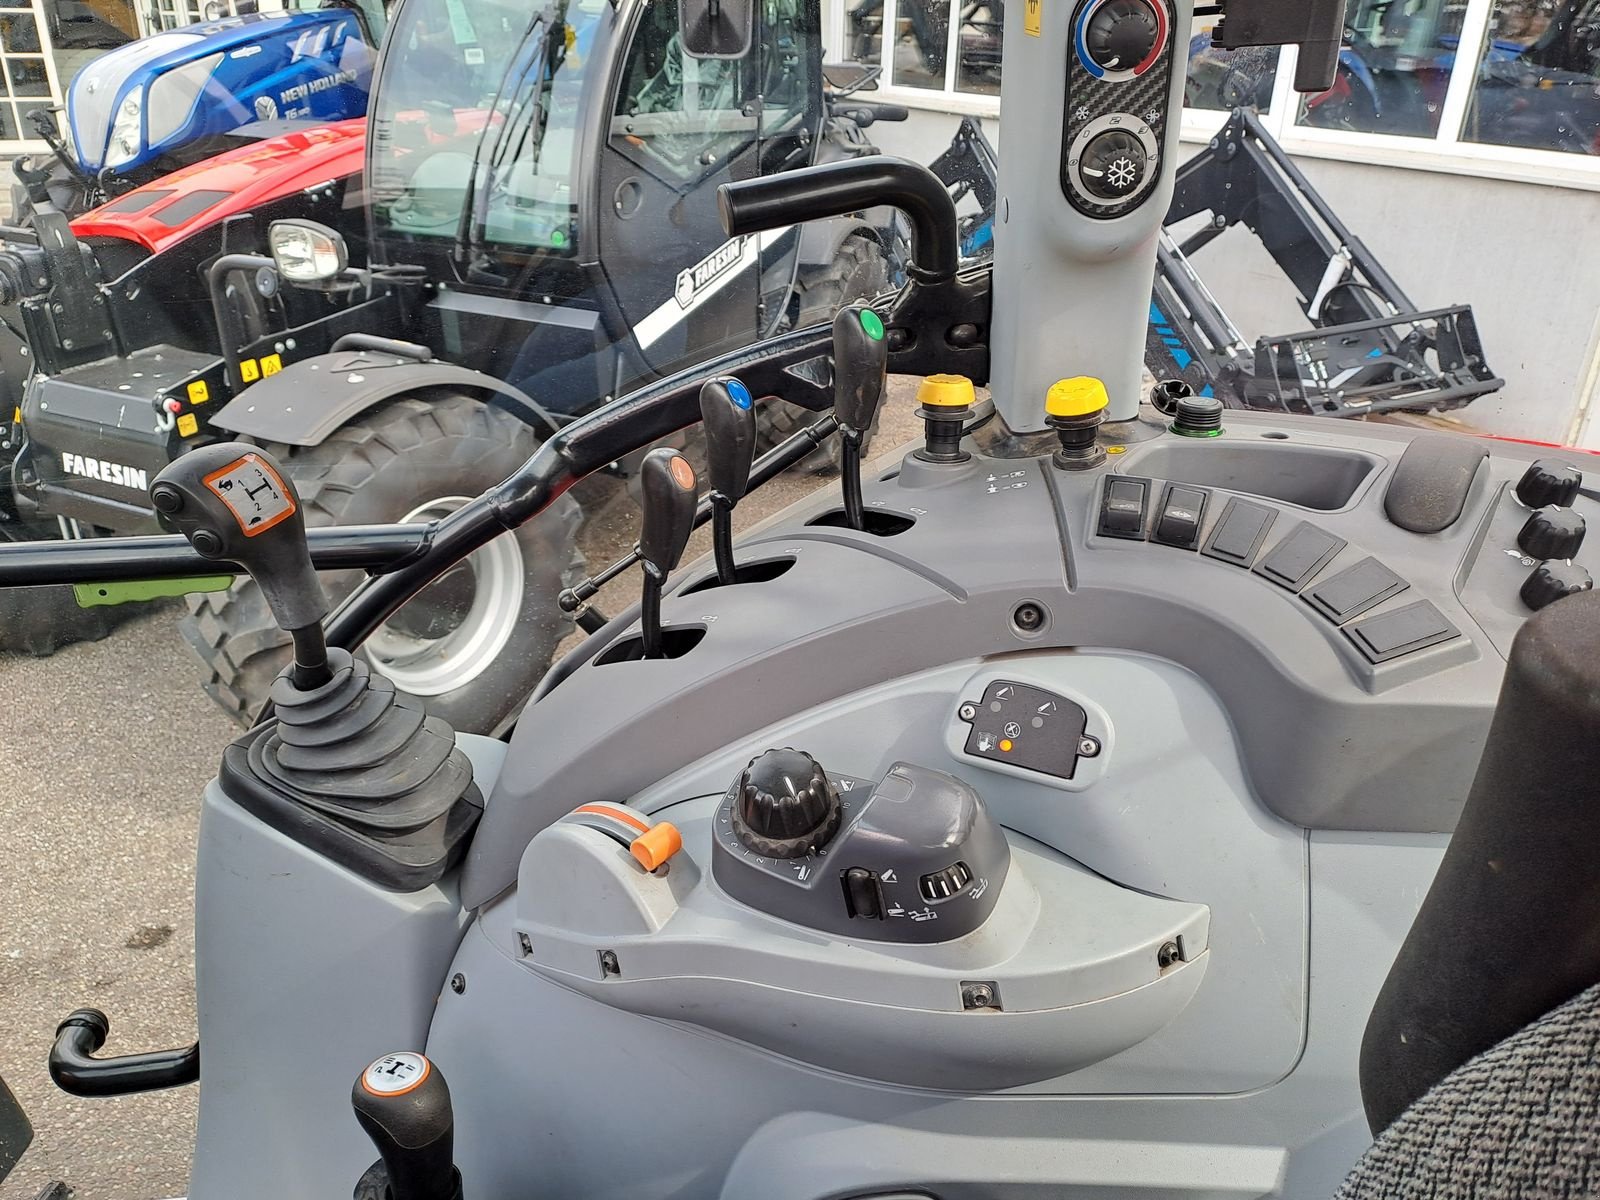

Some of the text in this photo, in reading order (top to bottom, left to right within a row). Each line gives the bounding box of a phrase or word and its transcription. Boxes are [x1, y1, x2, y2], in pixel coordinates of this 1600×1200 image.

[280, 83, 308, 104] NEW
[694, 238, 741, 289] FARESIN
[61, 451, 148, 492] FARESIN
[254, 468, 263, 477] 3
[237, 479, 245, 487] 1
[272, 491, 279, 500] 4
[254, 502, 262, 512] 2
[727, 792, 736, 800] 5
